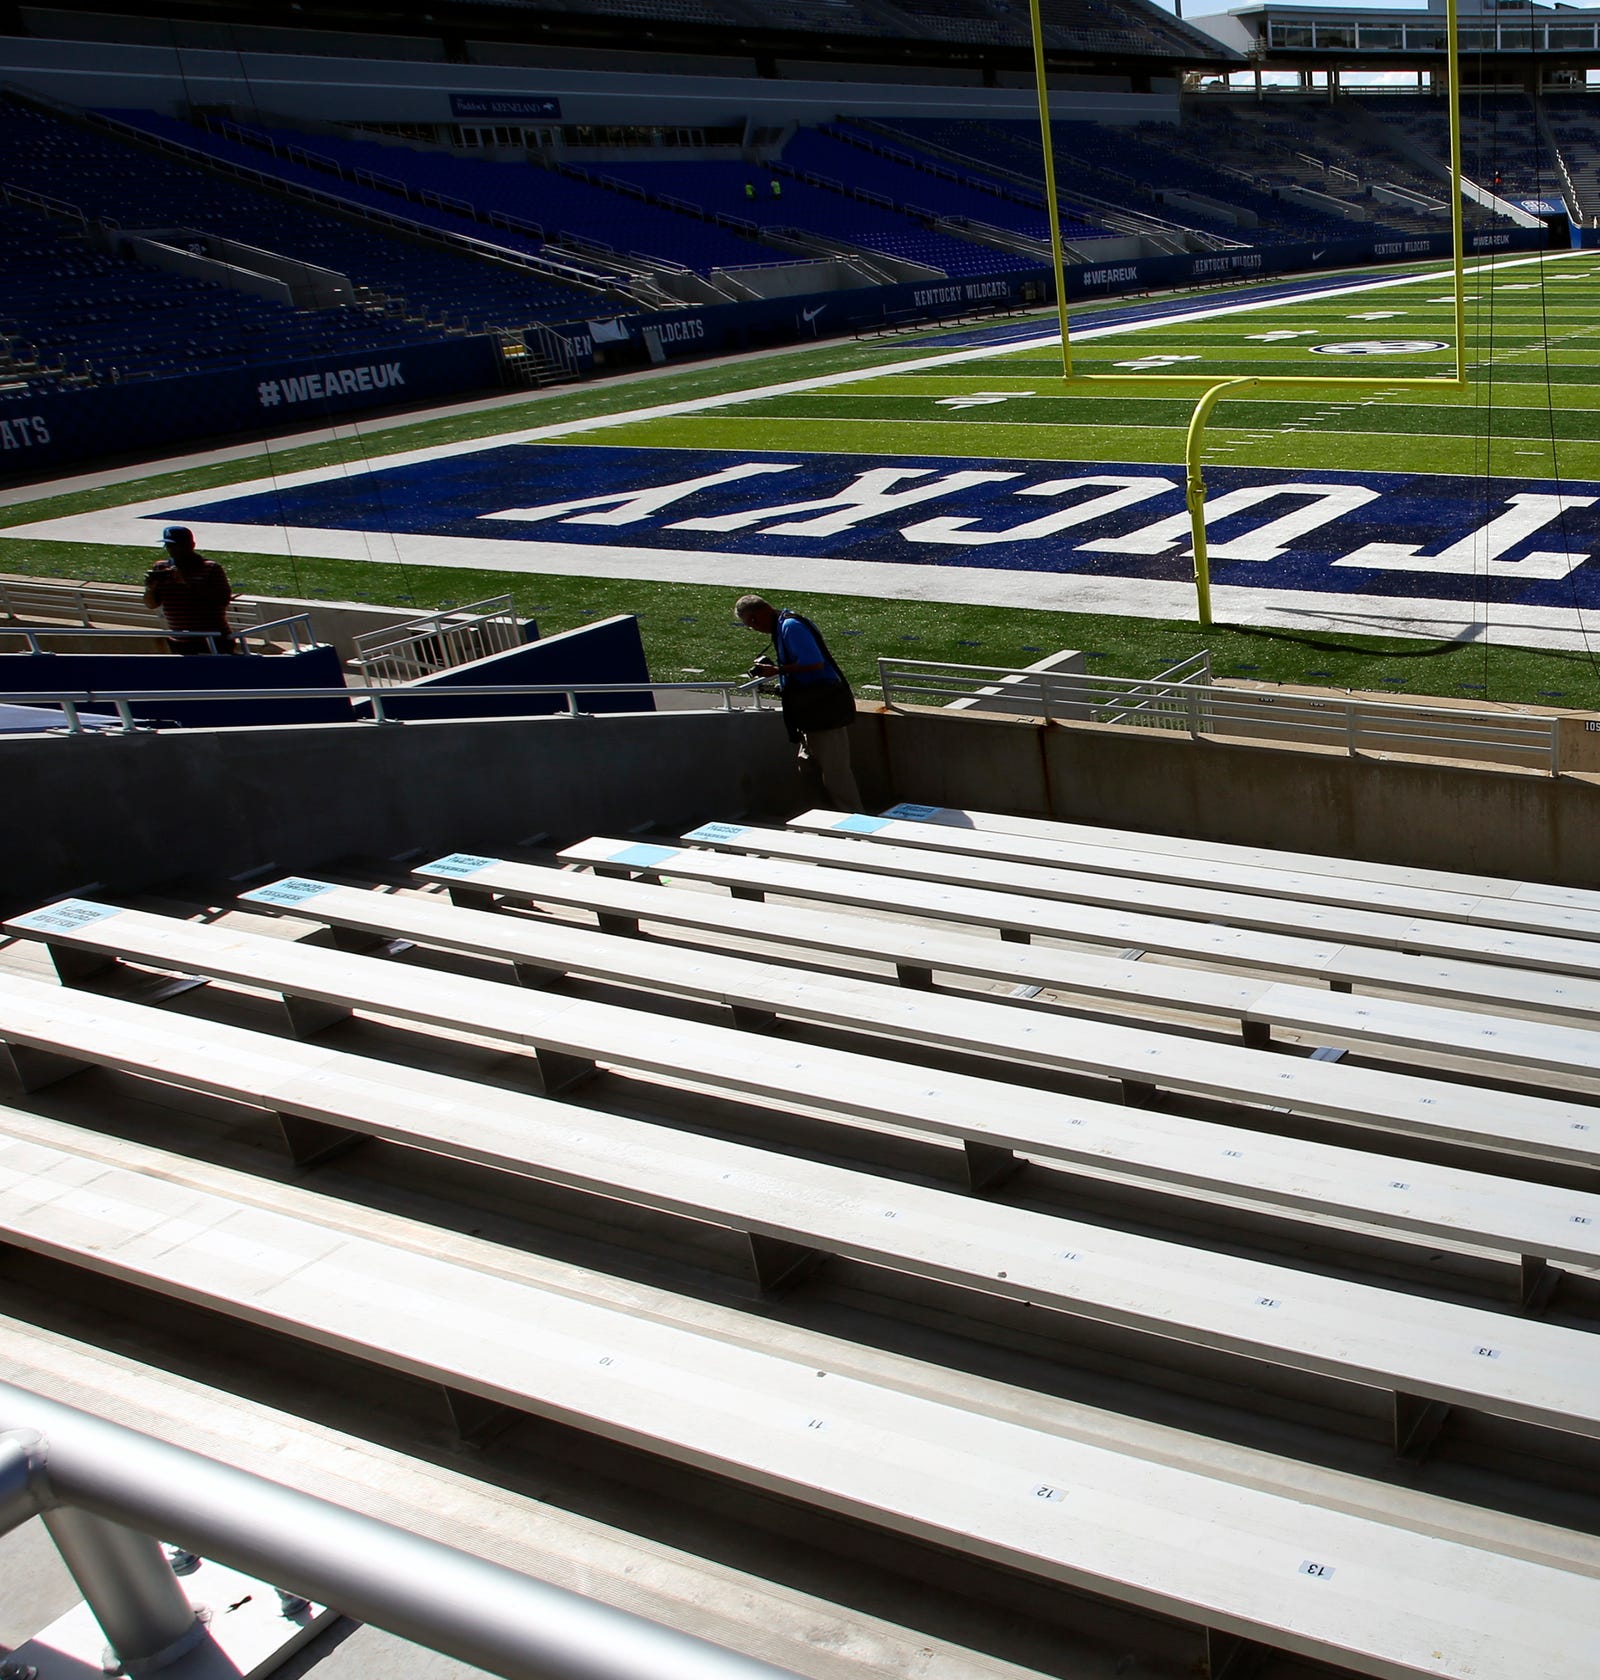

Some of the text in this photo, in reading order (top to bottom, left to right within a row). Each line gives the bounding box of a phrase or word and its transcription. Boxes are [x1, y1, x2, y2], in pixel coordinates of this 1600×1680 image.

[1374, 241, 1430, 255] KENTUCKY WILDCATS
[1194, 257, 1231, 273] KENTUCKY
[1083, 267, 1137, 286] #WEAREUK
[914, 281, 1008, 307] KENTUCKY WILDCATS
[258, 362, 406, 408] #WEAREUK
[1261, 1298, 1275, 1306] 12
[1479, 1347, 1493, 1357] 13
[599, 1357, 612, 1366] 10
[808, 1419, 824, 1428] 11
[1037, 1487, 1054, 1497] 12
[1308, 1564, 1324, 1575] 13
